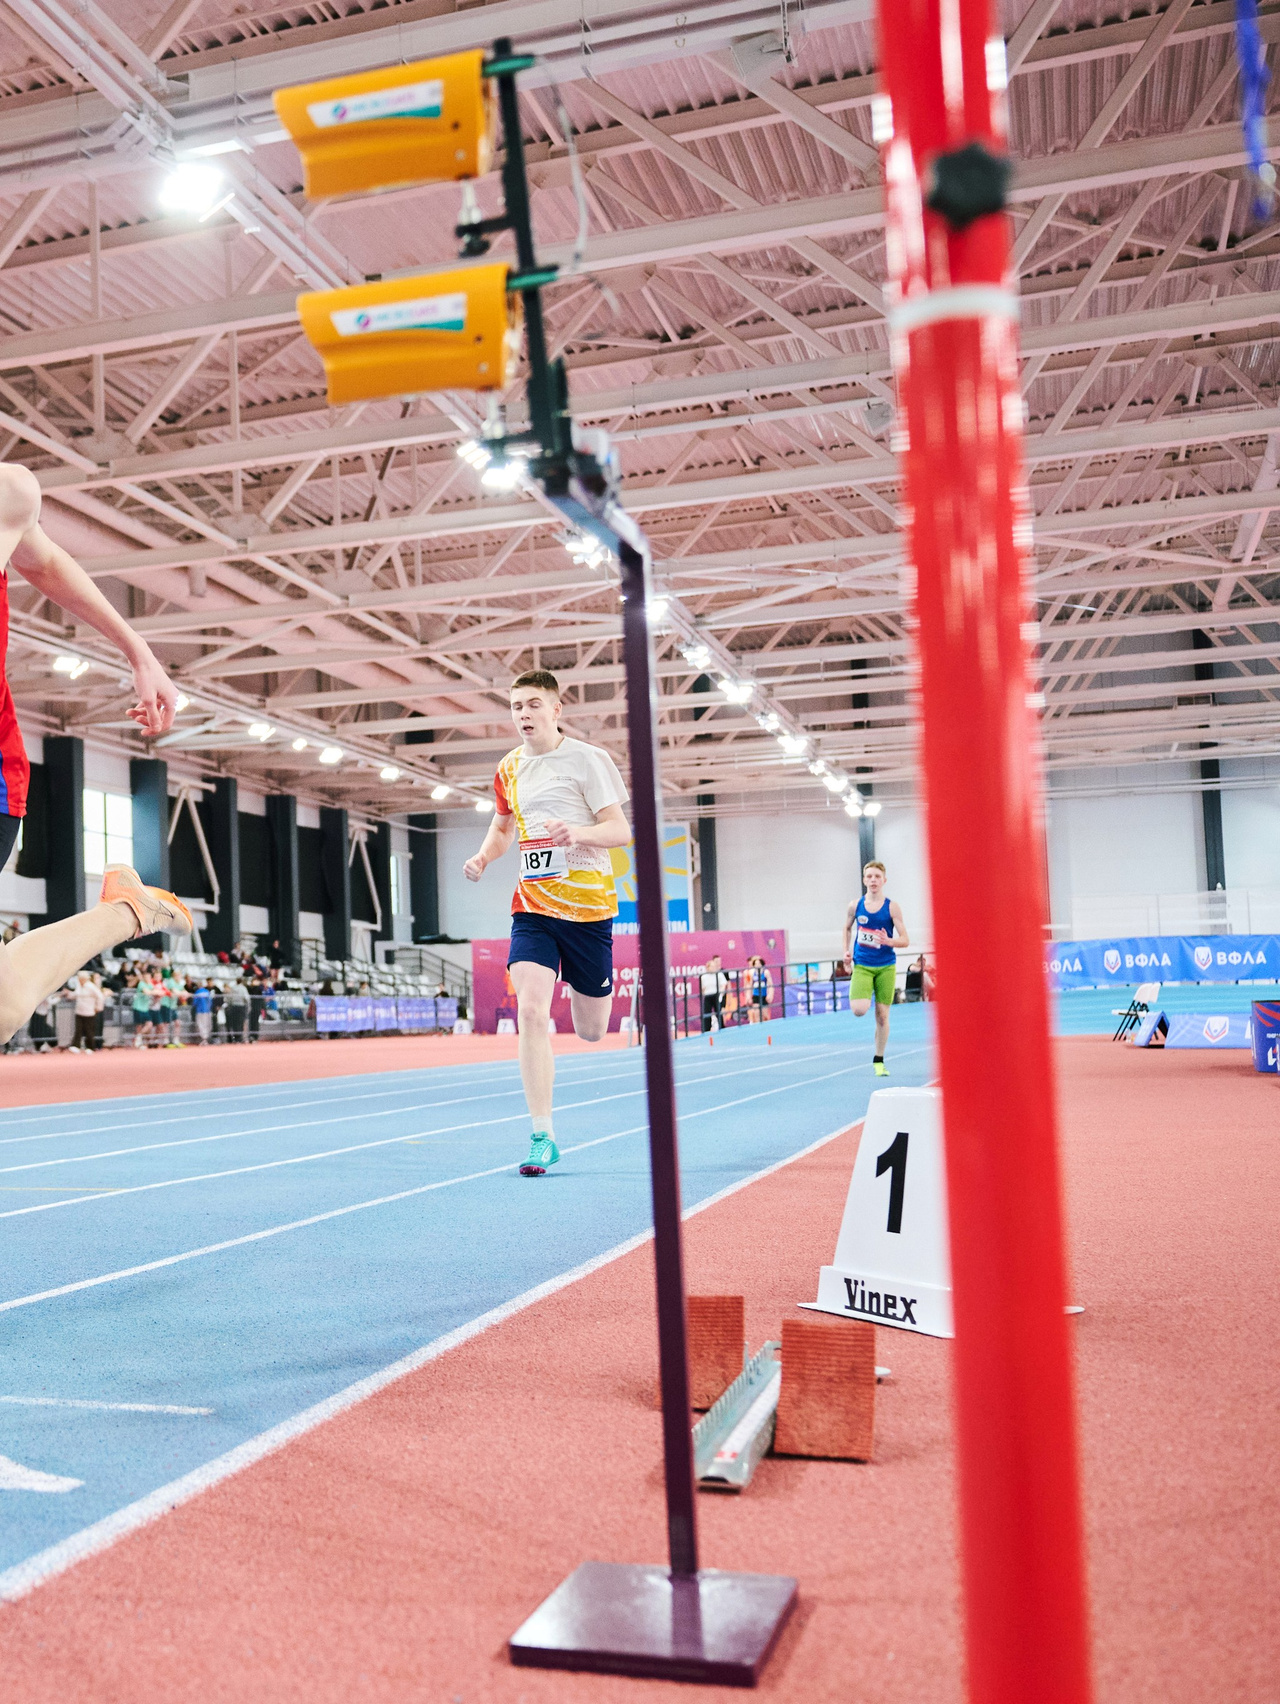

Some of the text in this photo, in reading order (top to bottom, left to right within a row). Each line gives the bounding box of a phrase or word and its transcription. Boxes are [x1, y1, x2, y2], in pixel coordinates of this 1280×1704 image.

[524, 850, 553, 870] 187
[1125, 952, 1172, 968] ВФЛА
[1216, 950, 1267, 966] ВФЛА
[876, 1132, 910, 1234] 1
[844, 1278, 918, 1325] Vinex
